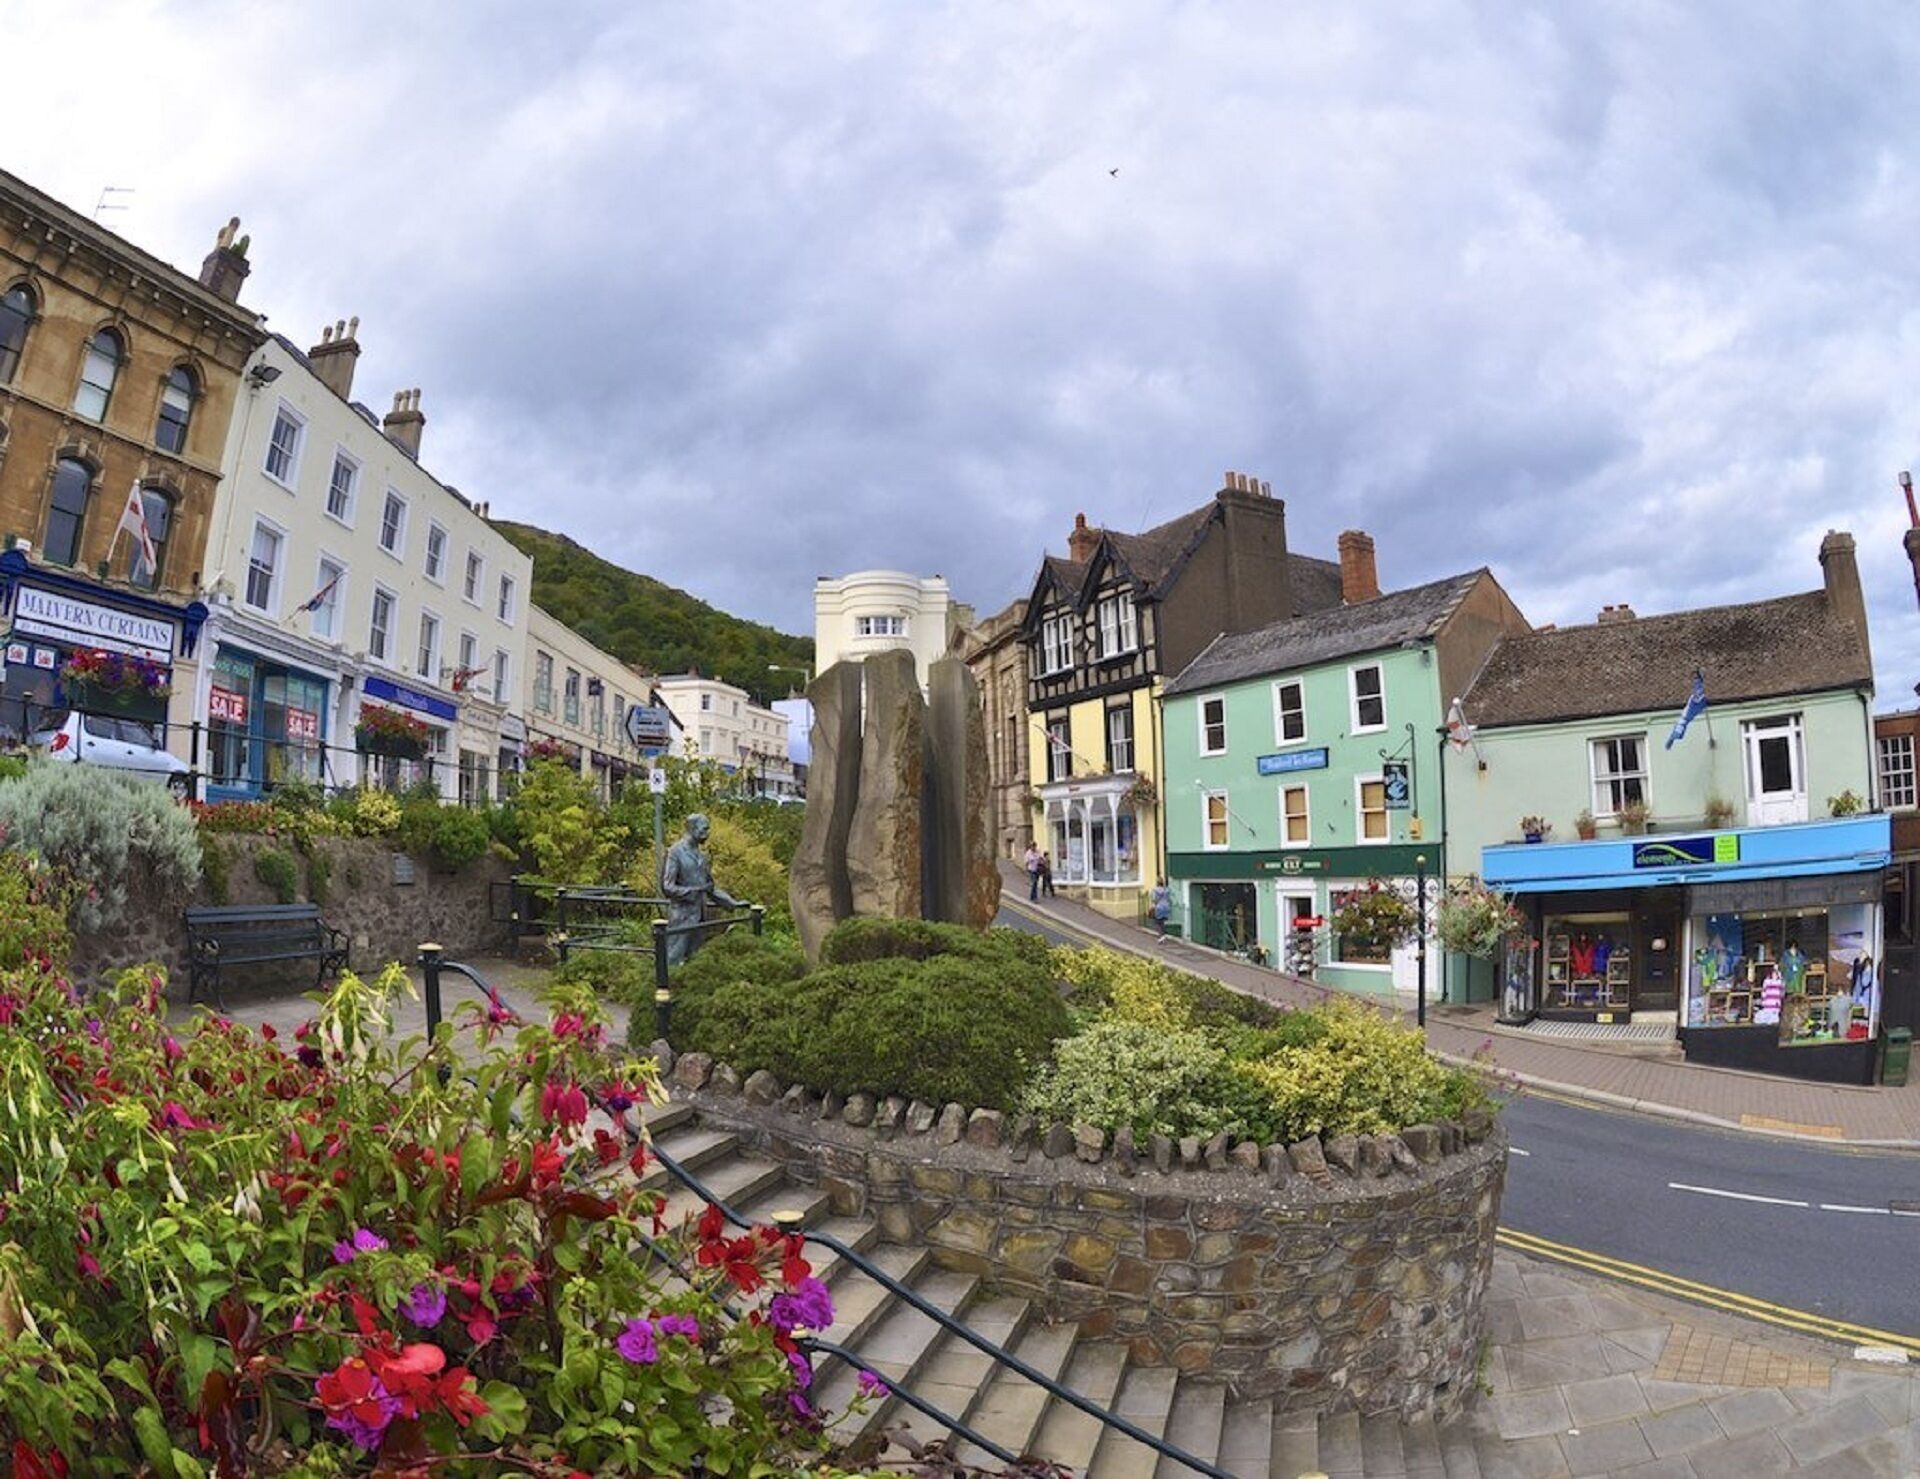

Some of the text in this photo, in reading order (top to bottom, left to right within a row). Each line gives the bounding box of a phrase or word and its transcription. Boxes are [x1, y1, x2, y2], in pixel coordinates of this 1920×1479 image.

[22, 592, 96, 628] MALVERN
[98, 613, 170, 645] CURTAINS
[209, 696, 244, 721] SALE
[288, 716, 316, 738] SALE
